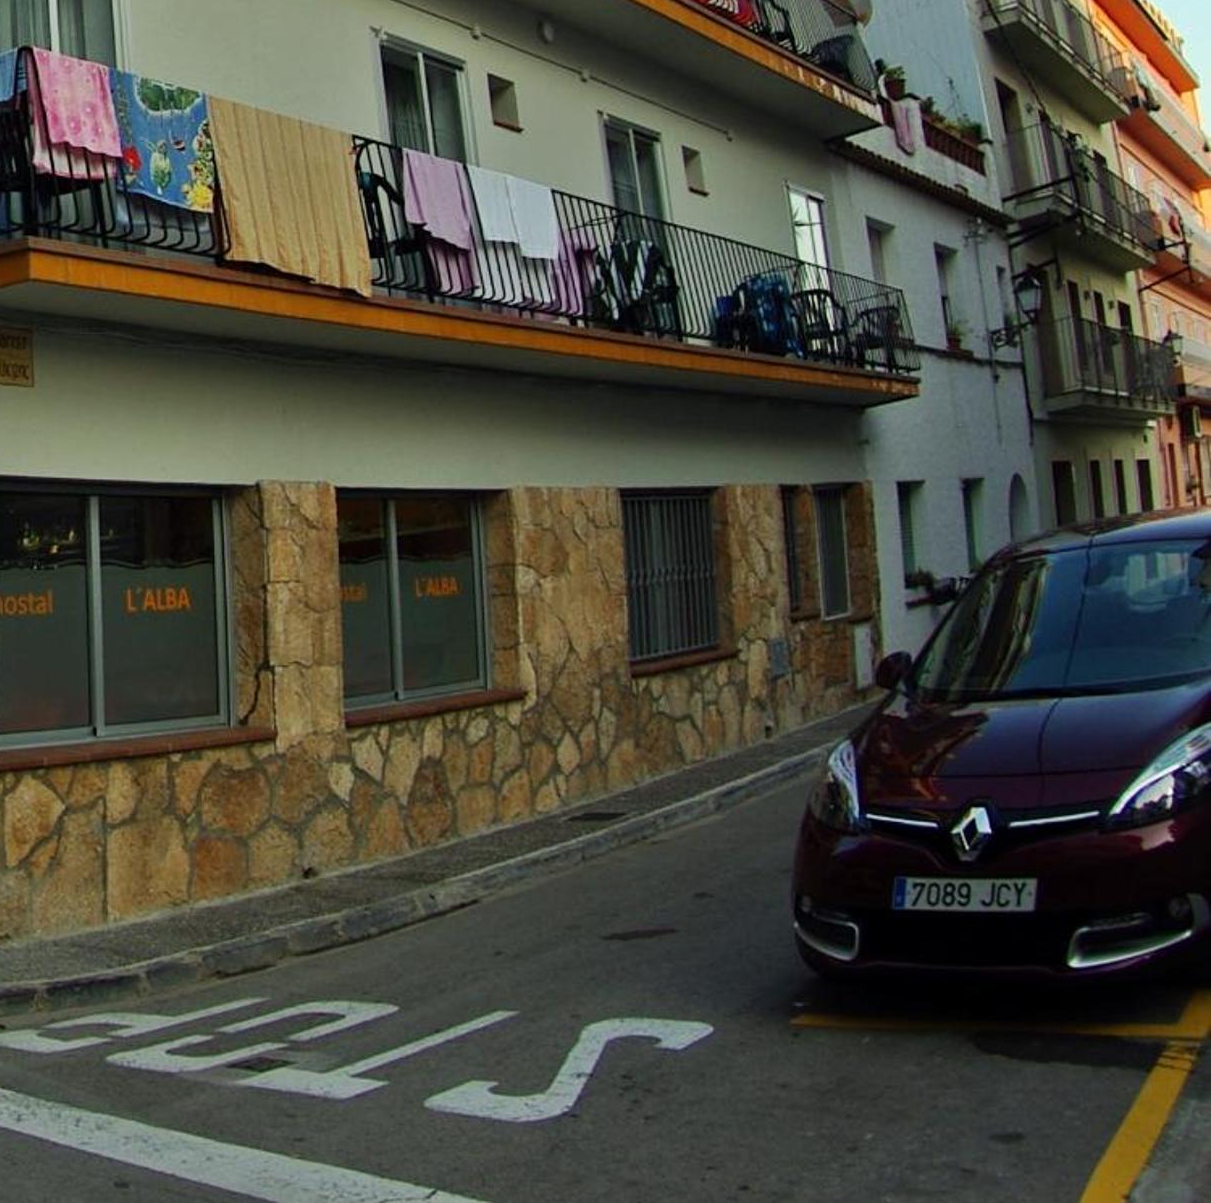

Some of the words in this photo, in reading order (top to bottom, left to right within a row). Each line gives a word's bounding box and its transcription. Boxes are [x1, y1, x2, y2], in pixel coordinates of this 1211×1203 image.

[125, 585, 192, 614] L'ALBA
[911, 882, 972, 907] 7089
[980, 882, 1027, 907] JCY
